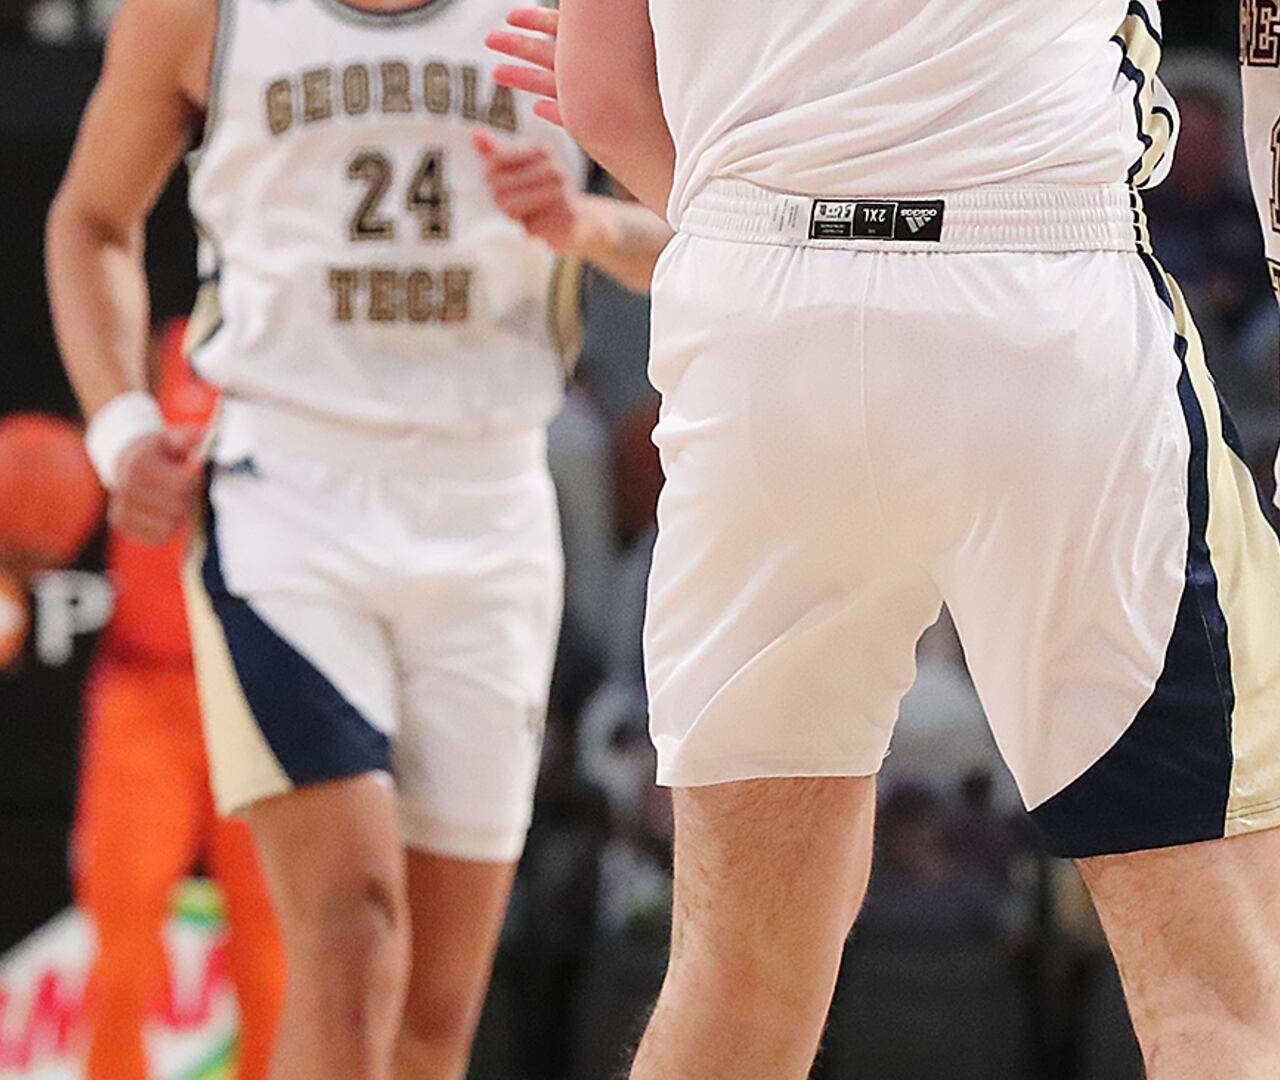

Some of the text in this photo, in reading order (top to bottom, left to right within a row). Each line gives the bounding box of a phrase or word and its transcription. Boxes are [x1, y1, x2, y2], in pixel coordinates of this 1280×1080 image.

[265, 60, 519, 136] GEORGIA
[346, 147, 455, 243] 24
[862, 208, 887, 223] 2XL
[901, 208, 938, 218] adidas
[328, 267, 474, 325] TECH
